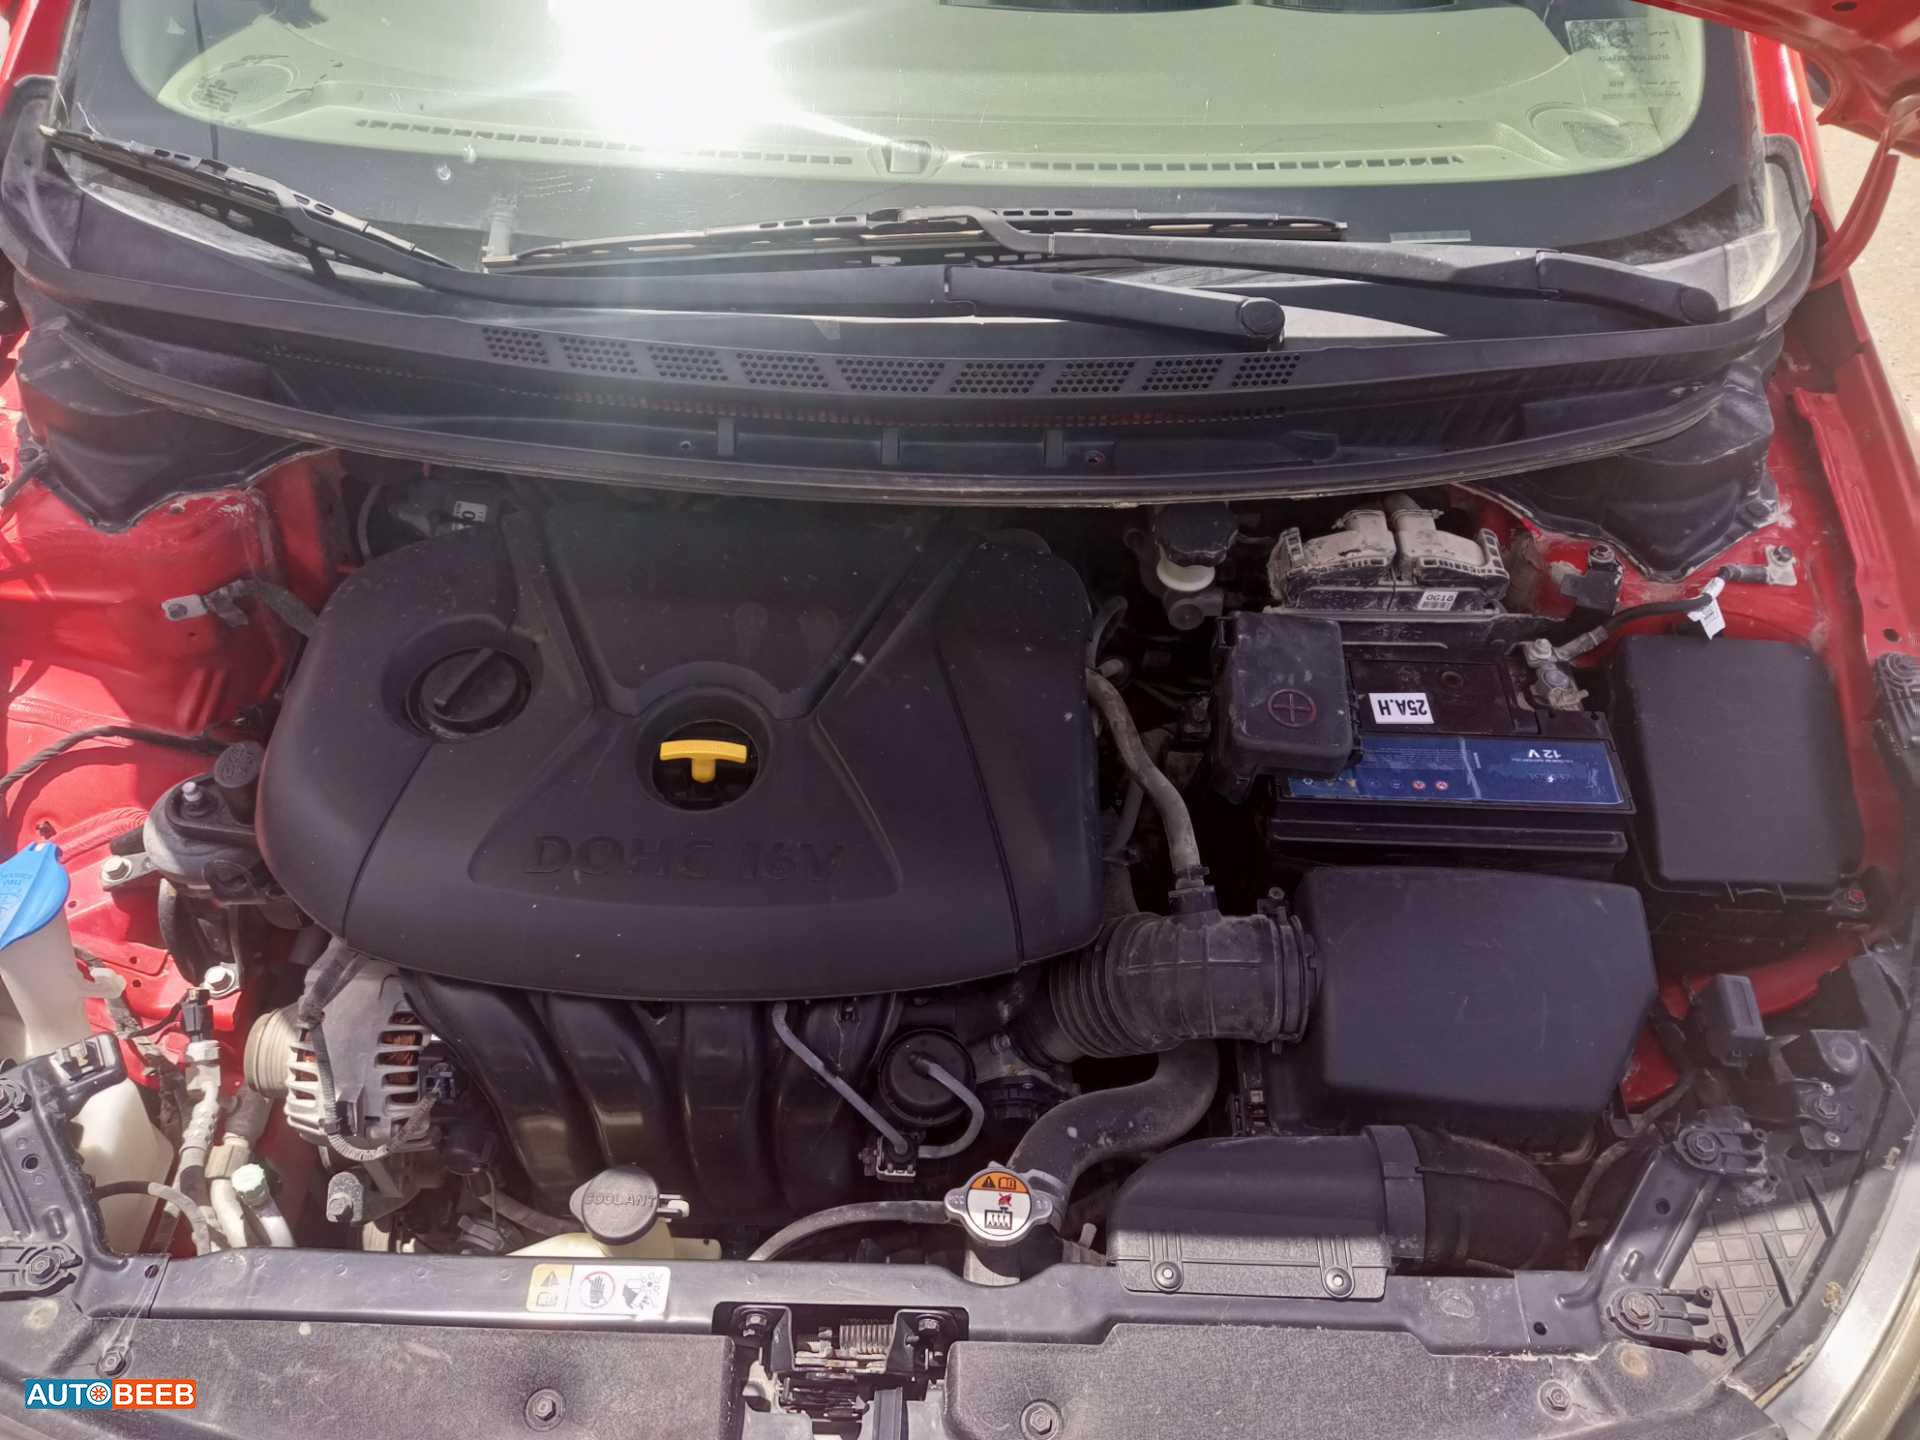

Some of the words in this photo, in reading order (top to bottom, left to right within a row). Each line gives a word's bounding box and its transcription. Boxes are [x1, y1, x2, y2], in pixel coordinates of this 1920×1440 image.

[1377, 699, 1428, 716] 25A.H
[1528, 748, 1540, 758] V
[1542, 749, 1562, 759] 12
[530, 833, 714, 880] DOHC
[738, 838, 847, 882] 16V
[583, 1191, 657, 1207] COOLANT
